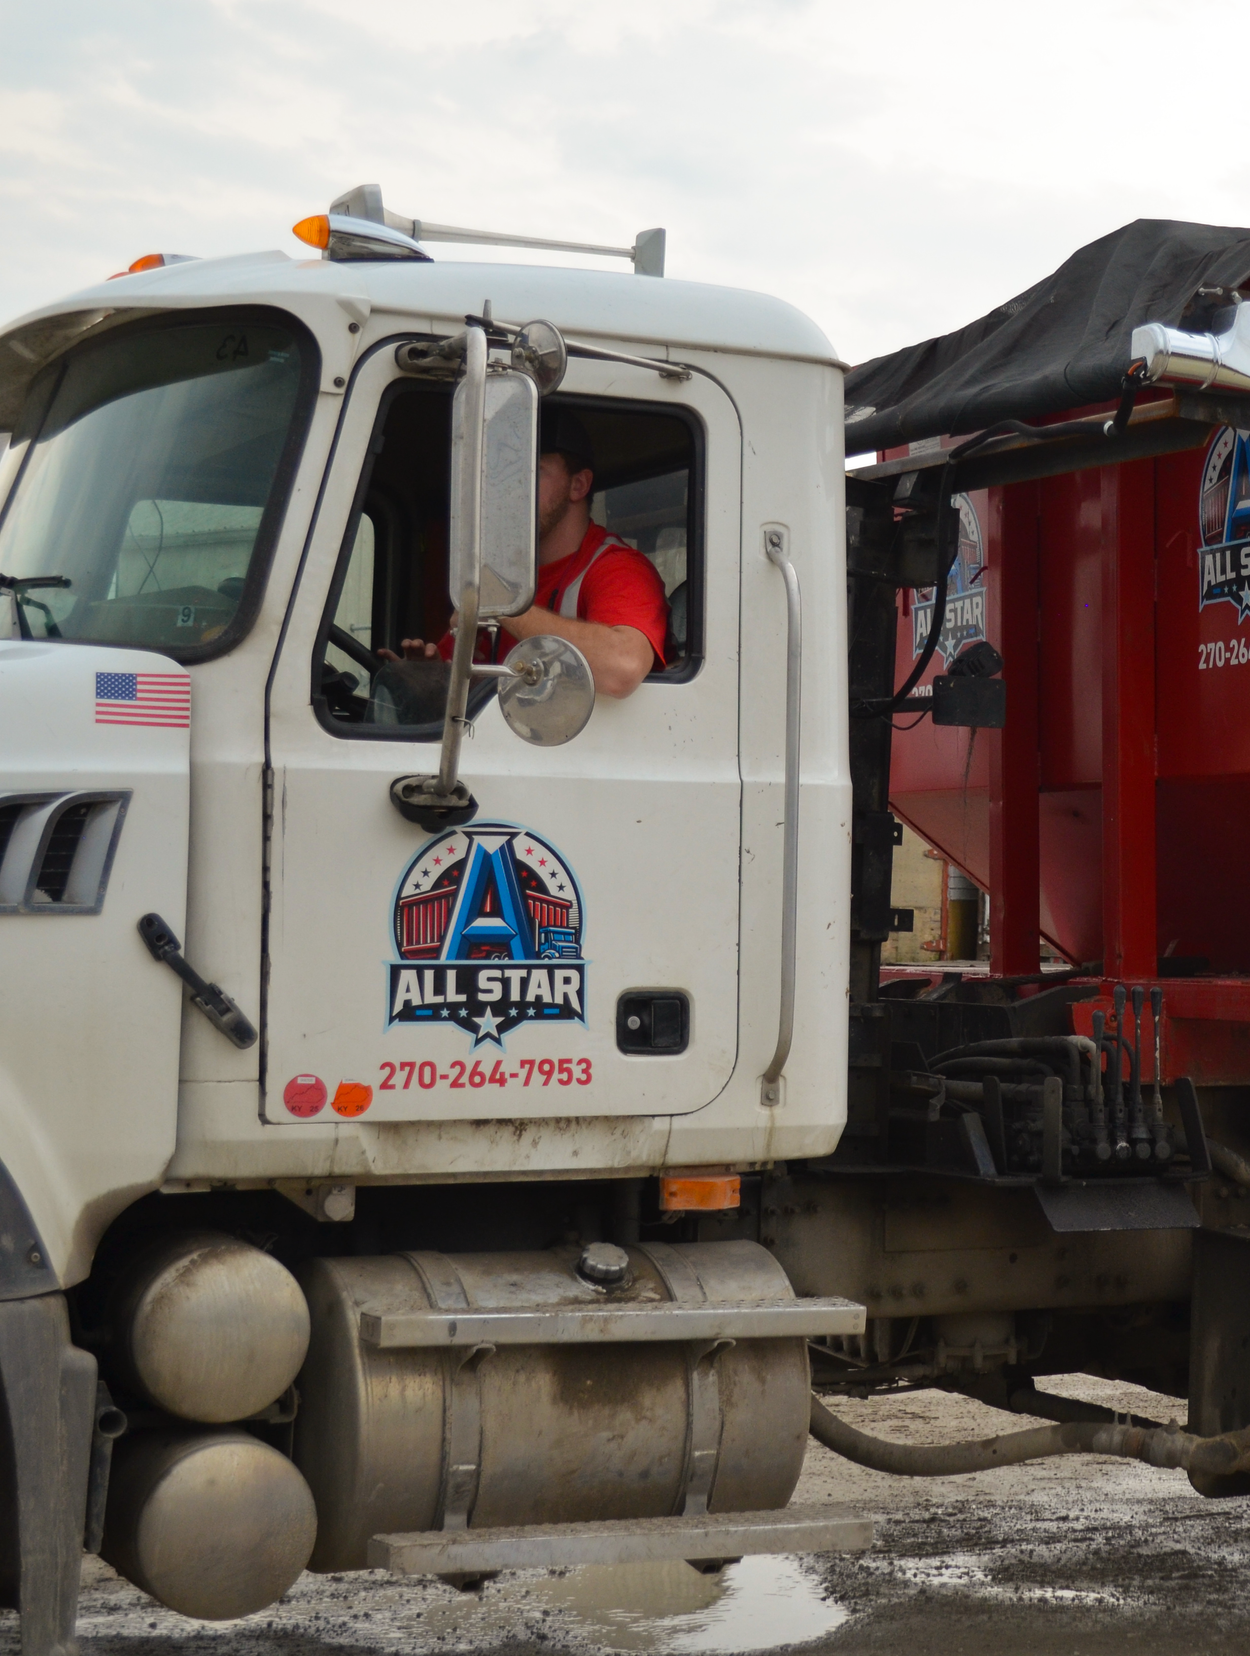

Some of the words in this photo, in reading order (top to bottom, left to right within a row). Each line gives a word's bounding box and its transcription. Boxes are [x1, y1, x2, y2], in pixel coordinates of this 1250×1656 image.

[1203, 551, 1236, 597] ALL
[945, 596, 983, 631] STAR
[392, 969, 467, 1017] ALL
[477, 968, 582, 1015] STAR
[379, 1057, 593, 1091] 270-264-7953
